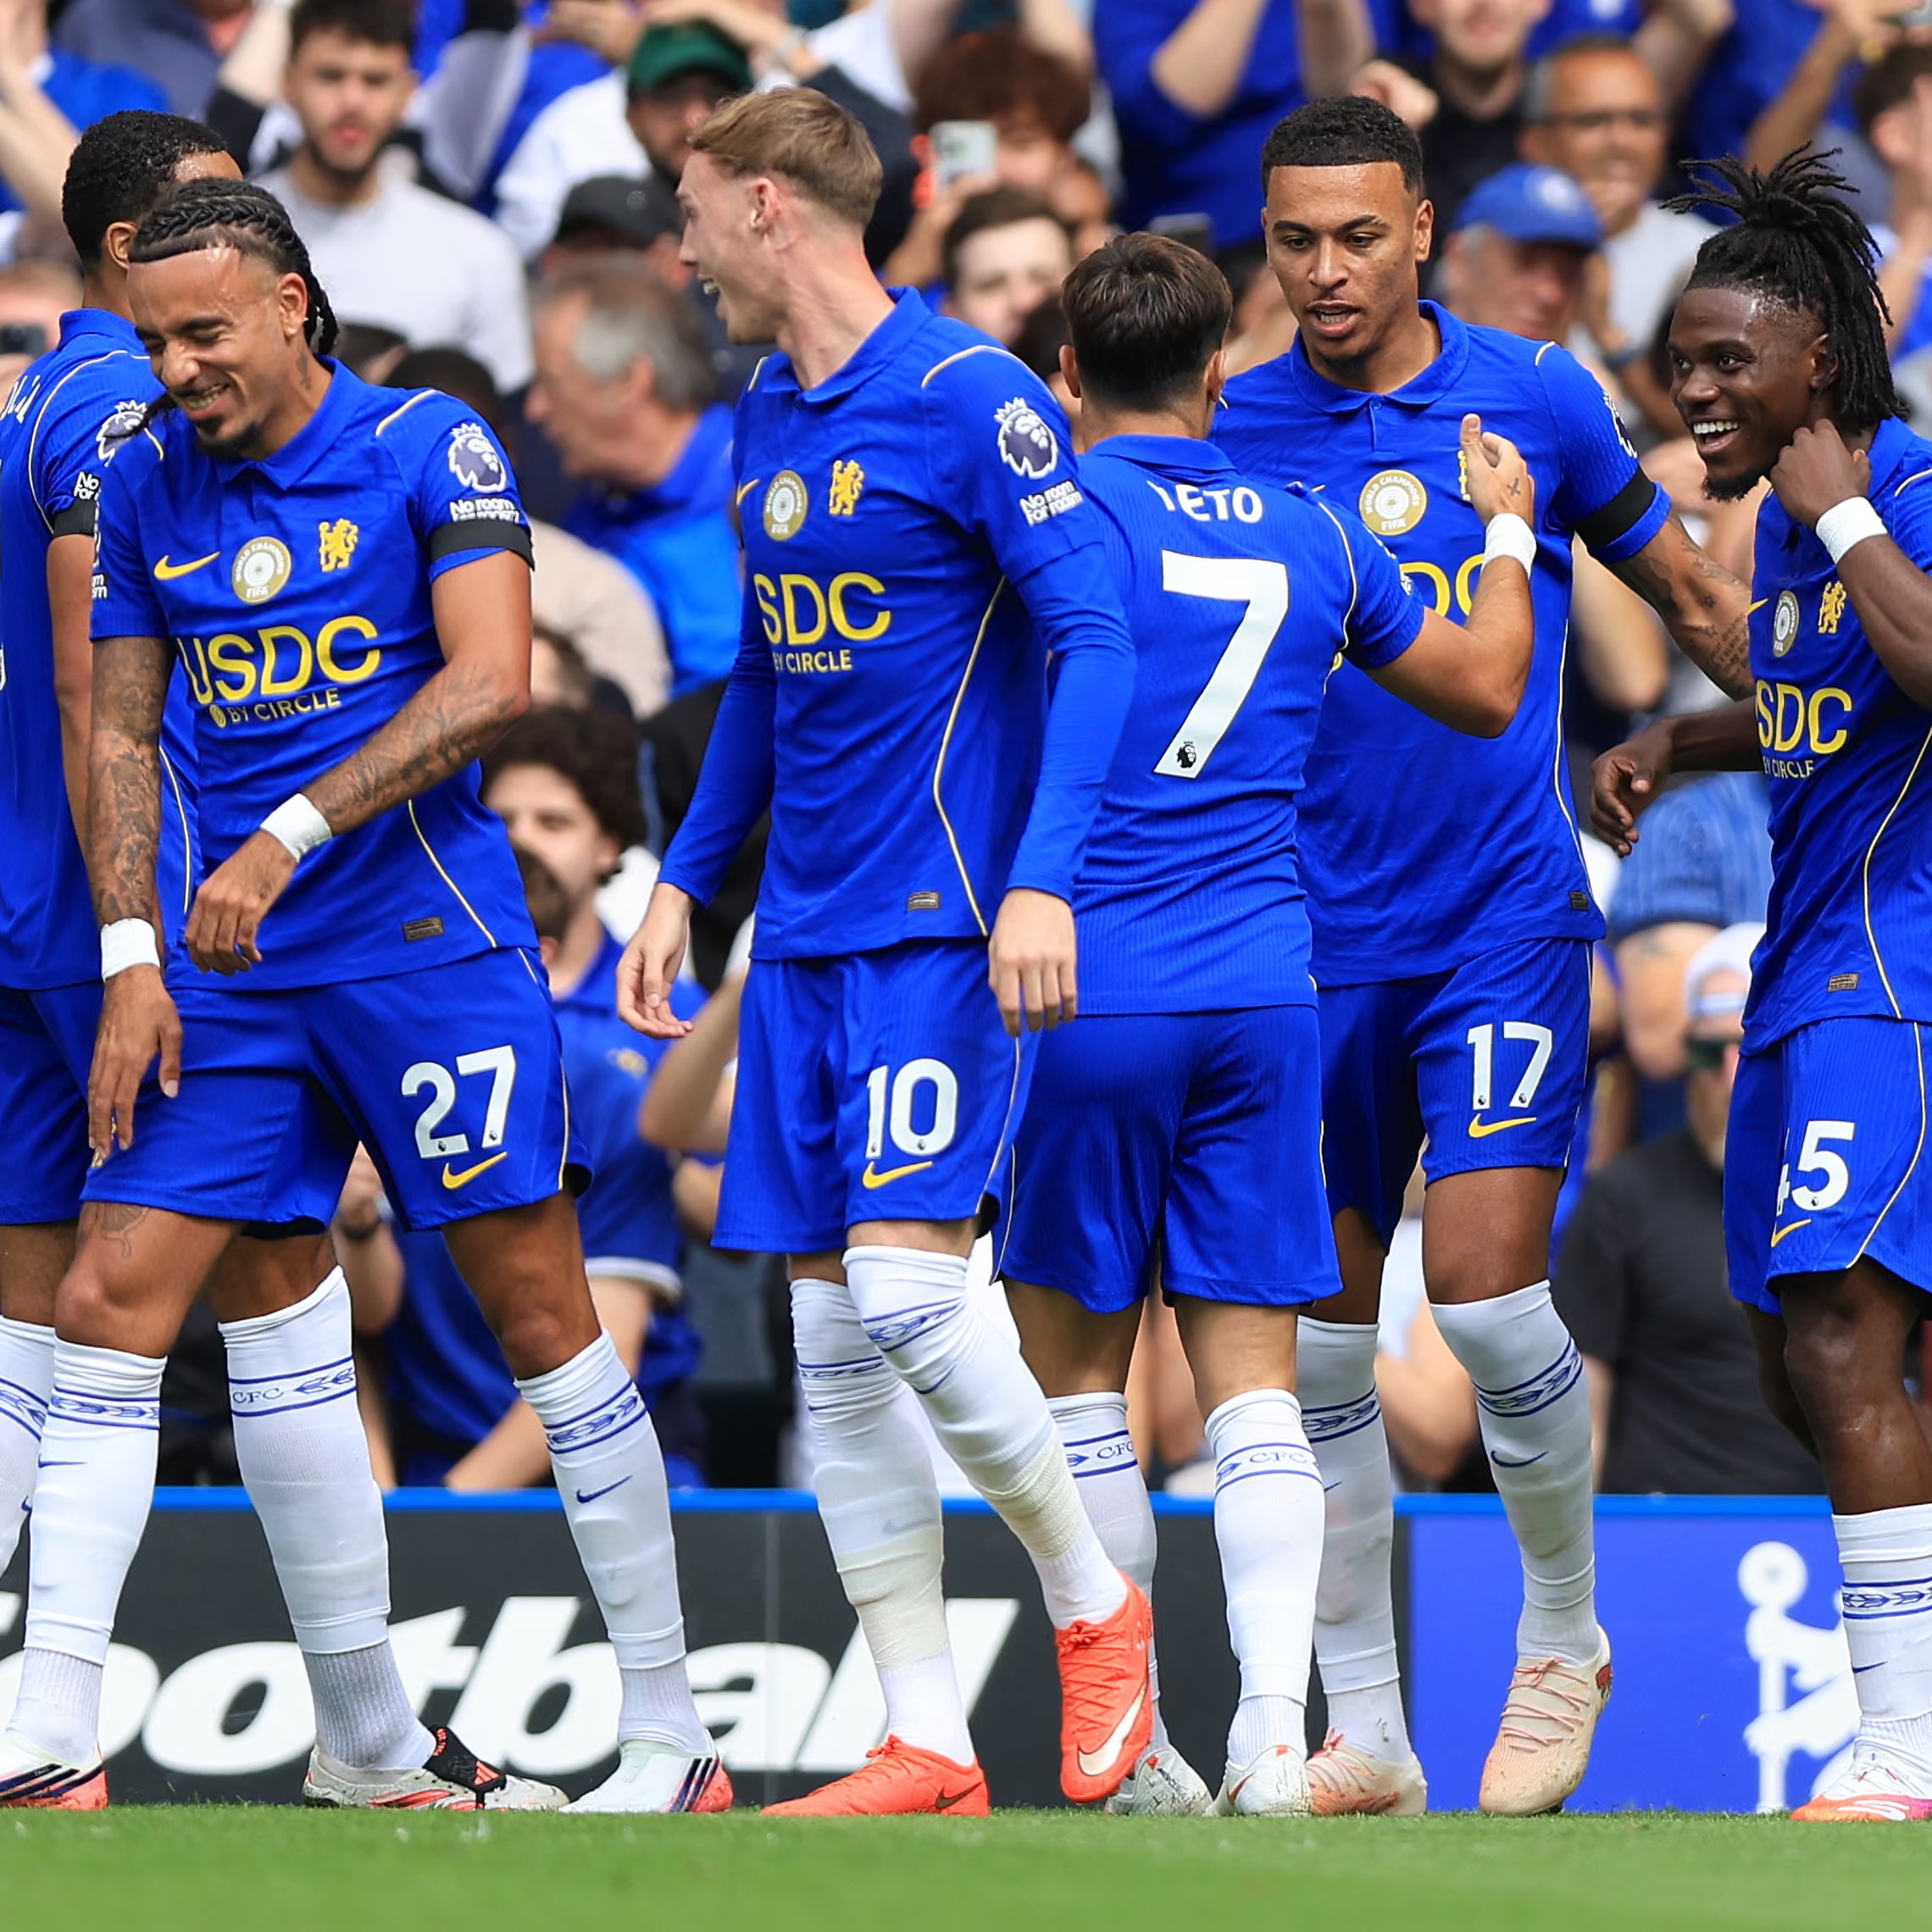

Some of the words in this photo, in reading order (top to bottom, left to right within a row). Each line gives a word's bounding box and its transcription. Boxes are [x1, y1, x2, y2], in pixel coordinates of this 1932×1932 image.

[1381, 519, 1407, 530] FIFA
[753, 571, 891, 646] SDC
[175, 615, 380, 705] USDC
[786, 648, 853, 674] CIRCLE
[1152, 550, 1289, 779] 7
[227, 705, 249, 724] BY
[254, 687, 342, 721] CIRCLE
[1757, 680, 1852, 754] SDC
[401, 1045, 517, 1159] 27
[1467, 1021, 1553, 1110] 17
[866, 1058, 958, 1160] 10
[232, 1387, 285, 1404] CFC
[1249, 1451, 1308, 1464] CFC
